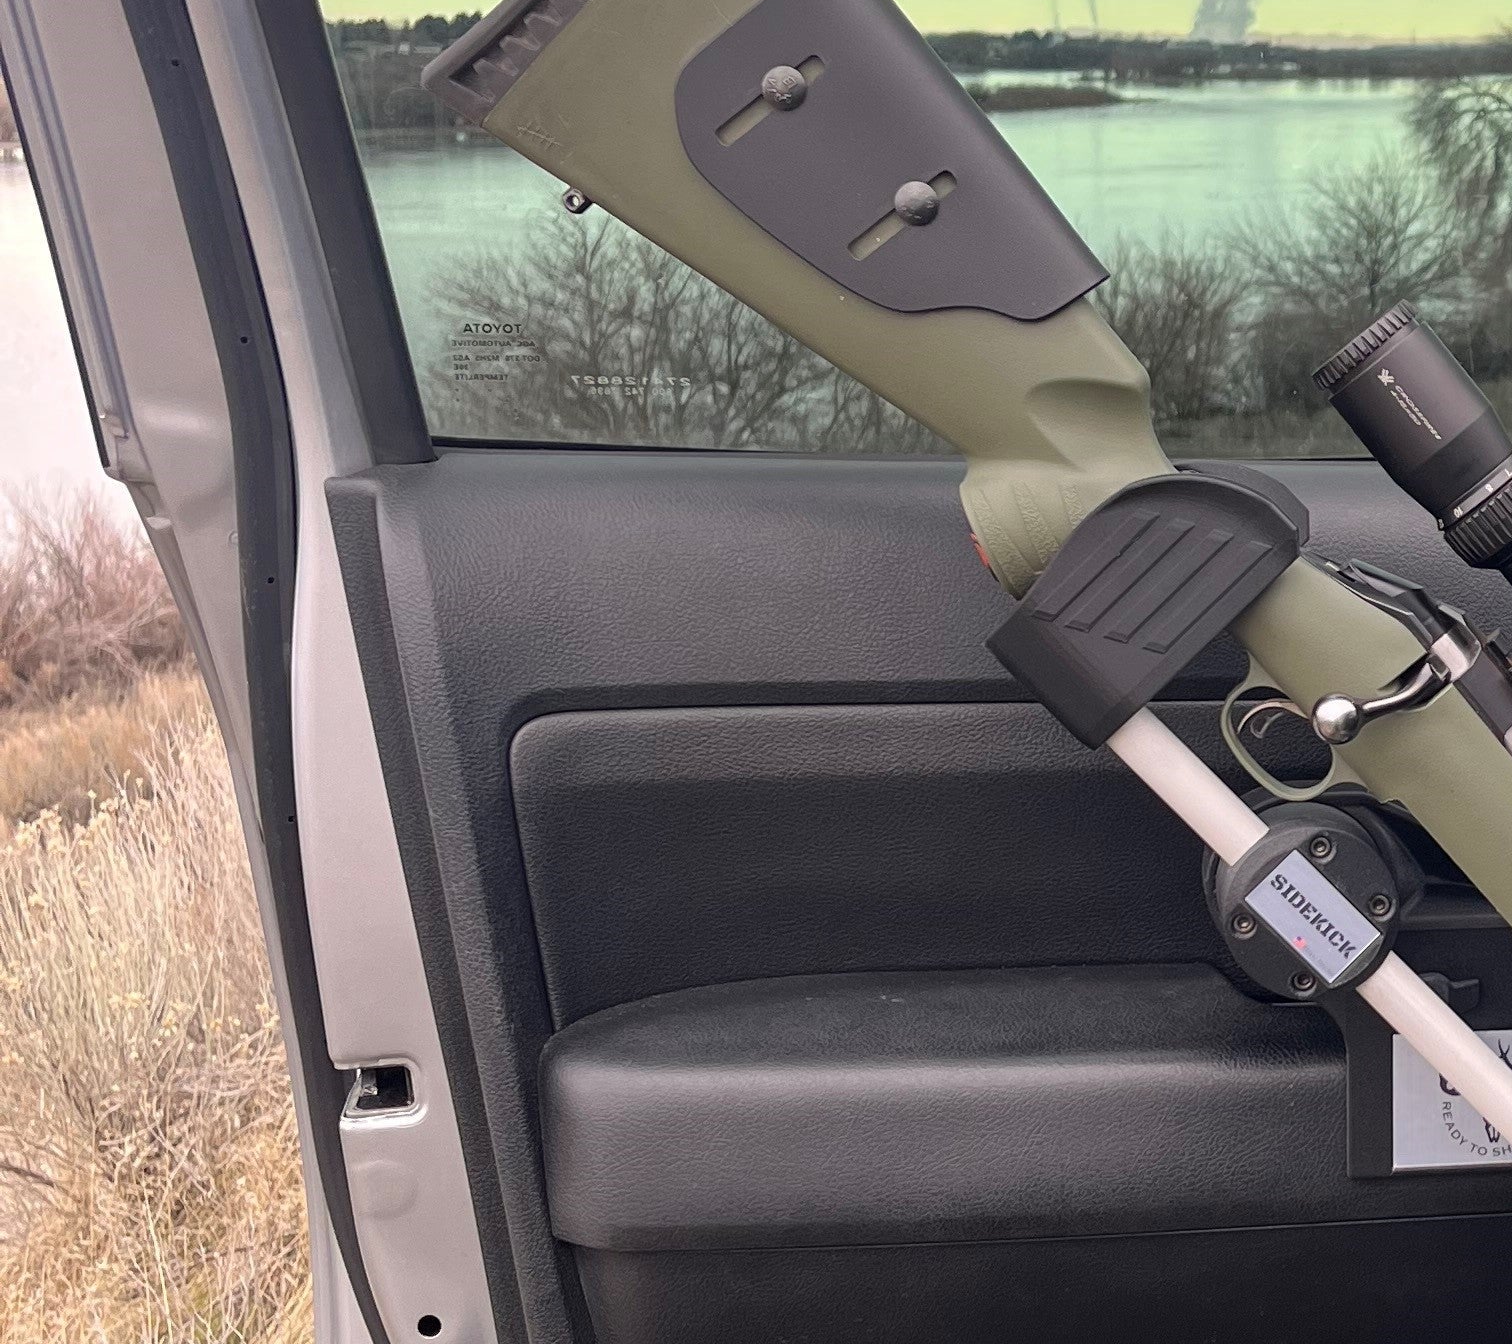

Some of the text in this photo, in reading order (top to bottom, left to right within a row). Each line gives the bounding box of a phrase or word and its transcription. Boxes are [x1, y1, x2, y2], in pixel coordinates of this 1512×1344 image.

[1270, 873, 1357, 960] SIDEKICK
[1442, 1101, 1468, 1145] READY
[1470, 1142, 1488, 1156] TO
